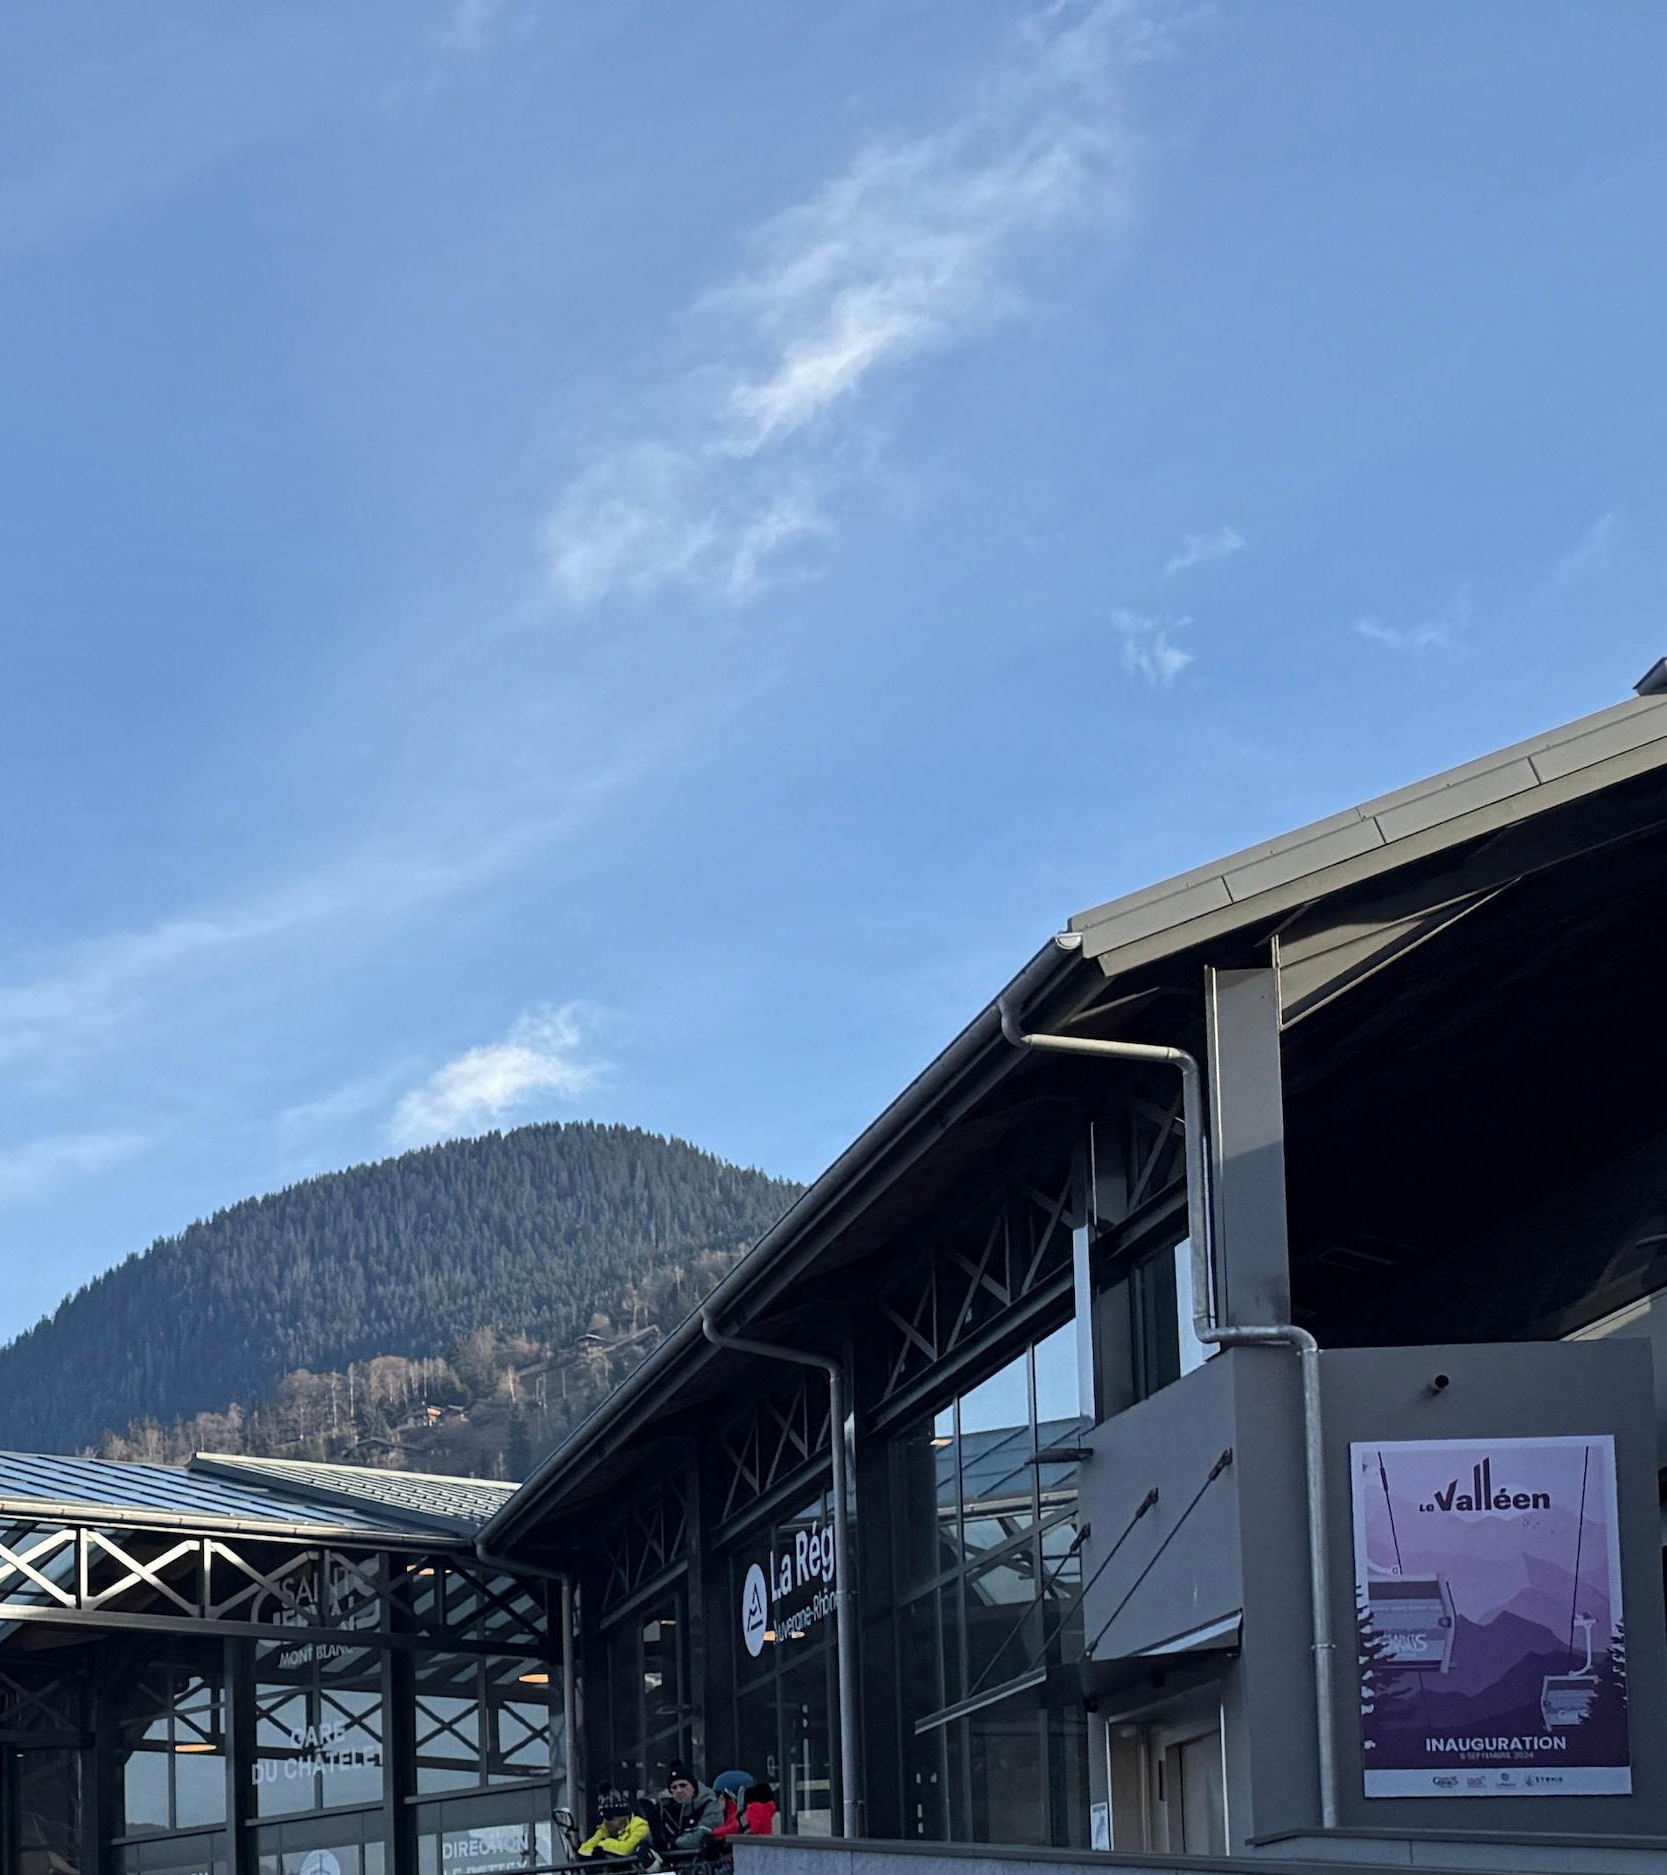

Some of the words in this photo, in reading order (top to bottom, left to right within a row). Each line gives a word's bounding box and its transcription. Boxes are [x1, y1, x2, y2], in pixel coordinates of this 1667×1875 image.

[1434, 1457, 1551, 1512] Valléen
[770, 1550, 793, 1602] La
[290, 1720, 346, 1747] GARE
[1425, 1736, 1567, 1752] INAUGURATION
[252, 1760, 278, 1785] DU
